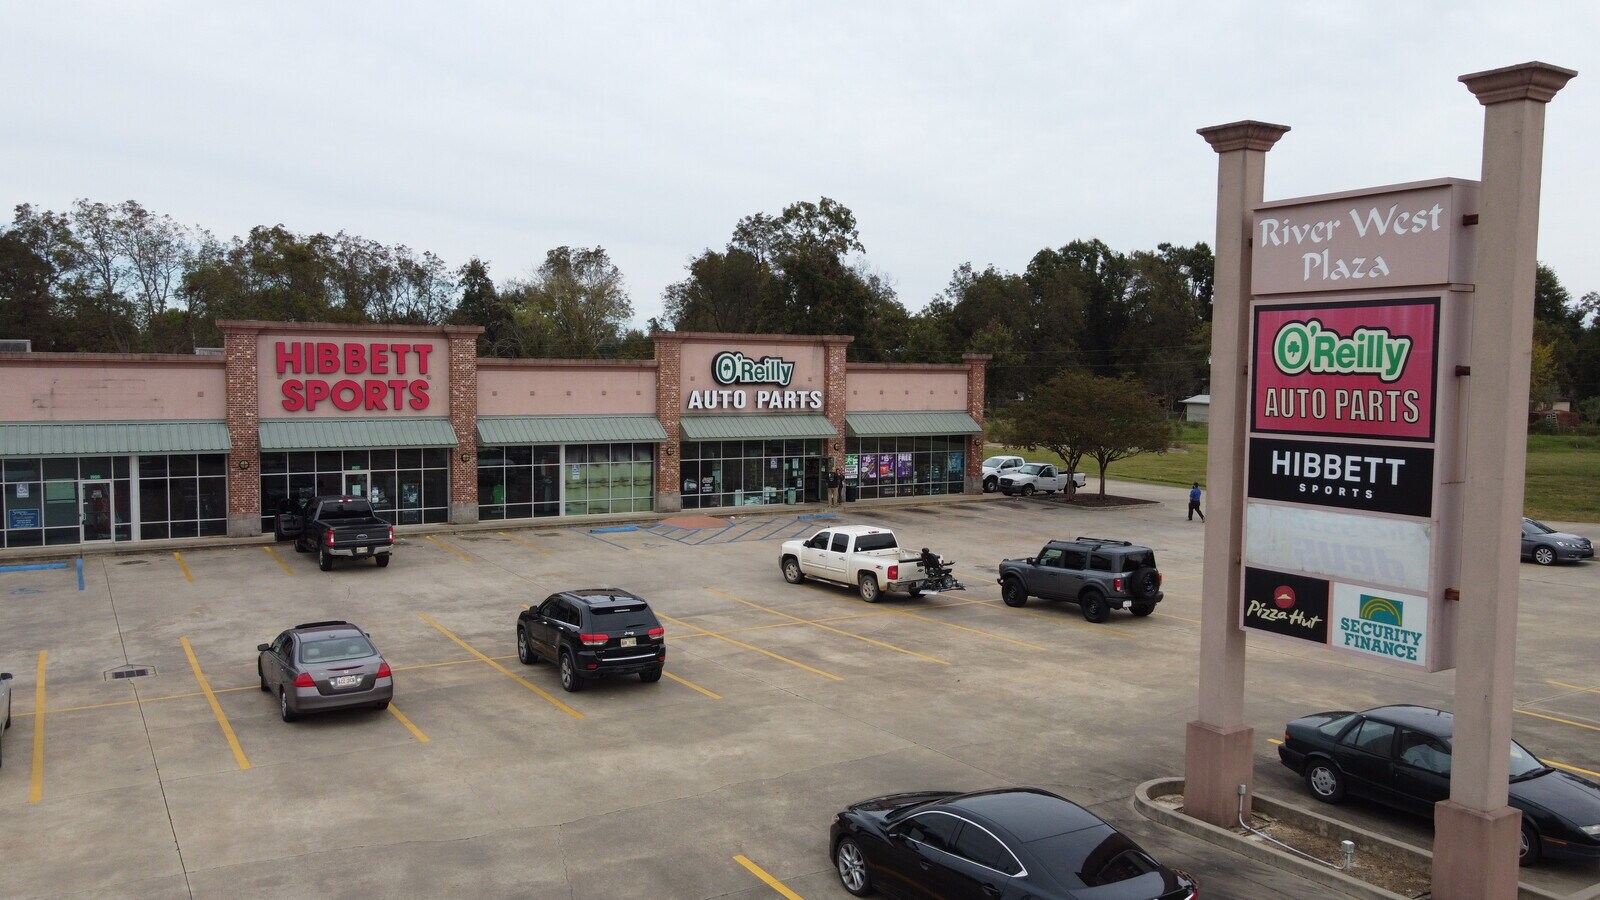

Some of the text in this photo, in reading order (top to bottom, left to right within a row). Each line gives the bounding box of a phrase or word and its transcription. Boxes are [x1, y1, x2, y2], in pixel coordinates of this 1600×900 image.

[1259, 203, 1444, 248] River West
[1302, 248, 1390, 281] Plaza
[276, 341, 433, 374] HIBBETT
[1277, 325, 1406, 376] O'Reilly
[717, 355, 792, 383] O'Reilly
[281, 379, 430, 411] SPORTS
[687, 390, 822, 409] AUTO PARTS
[1264, 388, 1420, 423] AUTO PARTS
[1271, 450, 1406, 486] HIBBETT
[1299, 483, 1374, 499] SPORTS
[1246, 599, 1323, 630] Pizza Hut
[1340, 617, 1423, 646] SECURITY
[1343, 632, 1418, 661] FINANCE
